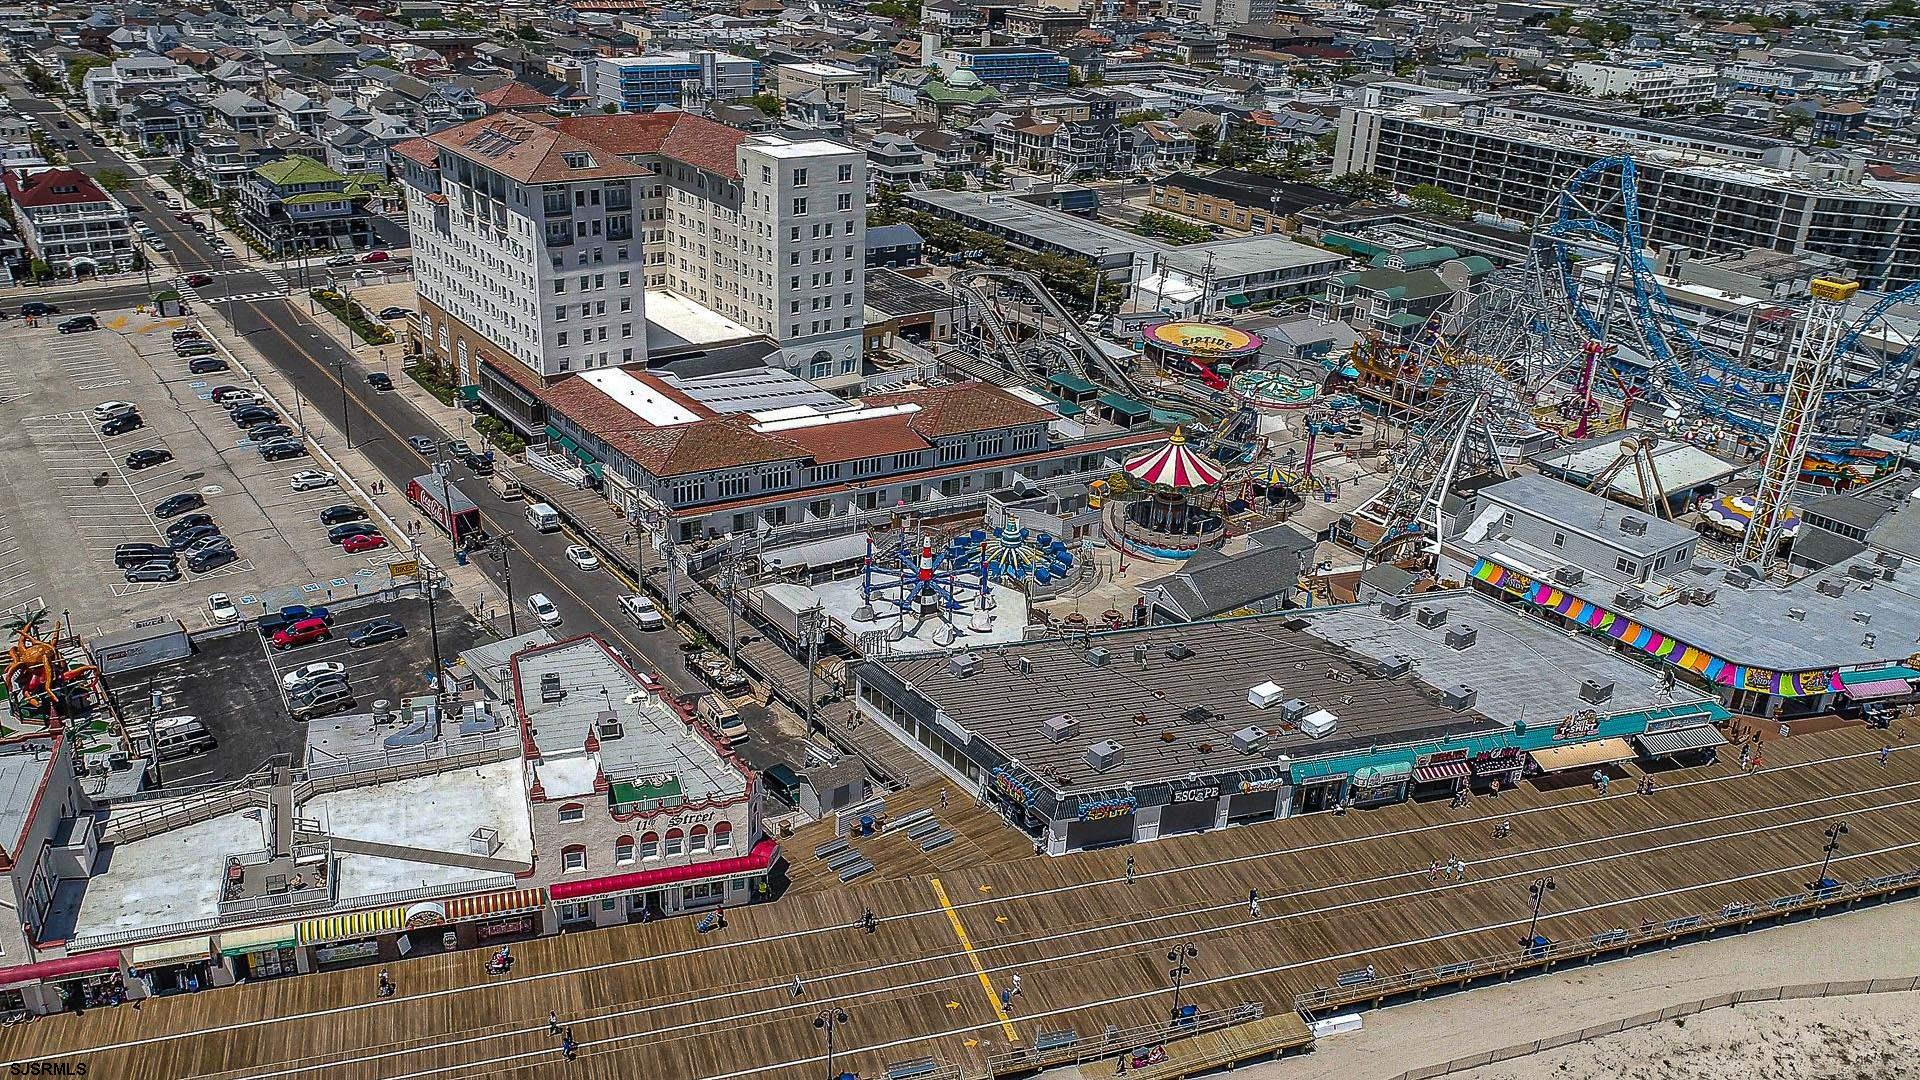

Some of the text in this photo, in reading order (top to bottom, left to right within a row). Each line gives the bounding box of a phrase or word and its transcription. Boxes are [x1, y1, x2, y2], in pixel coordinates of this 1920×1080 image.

[1181, 336, 1233, 349] RIPTIDE
[395, 564, 415, 574] BIKES
[1560, 723, 1597, 735] T-SHIRT
[667, 811, 716, 828] Street
